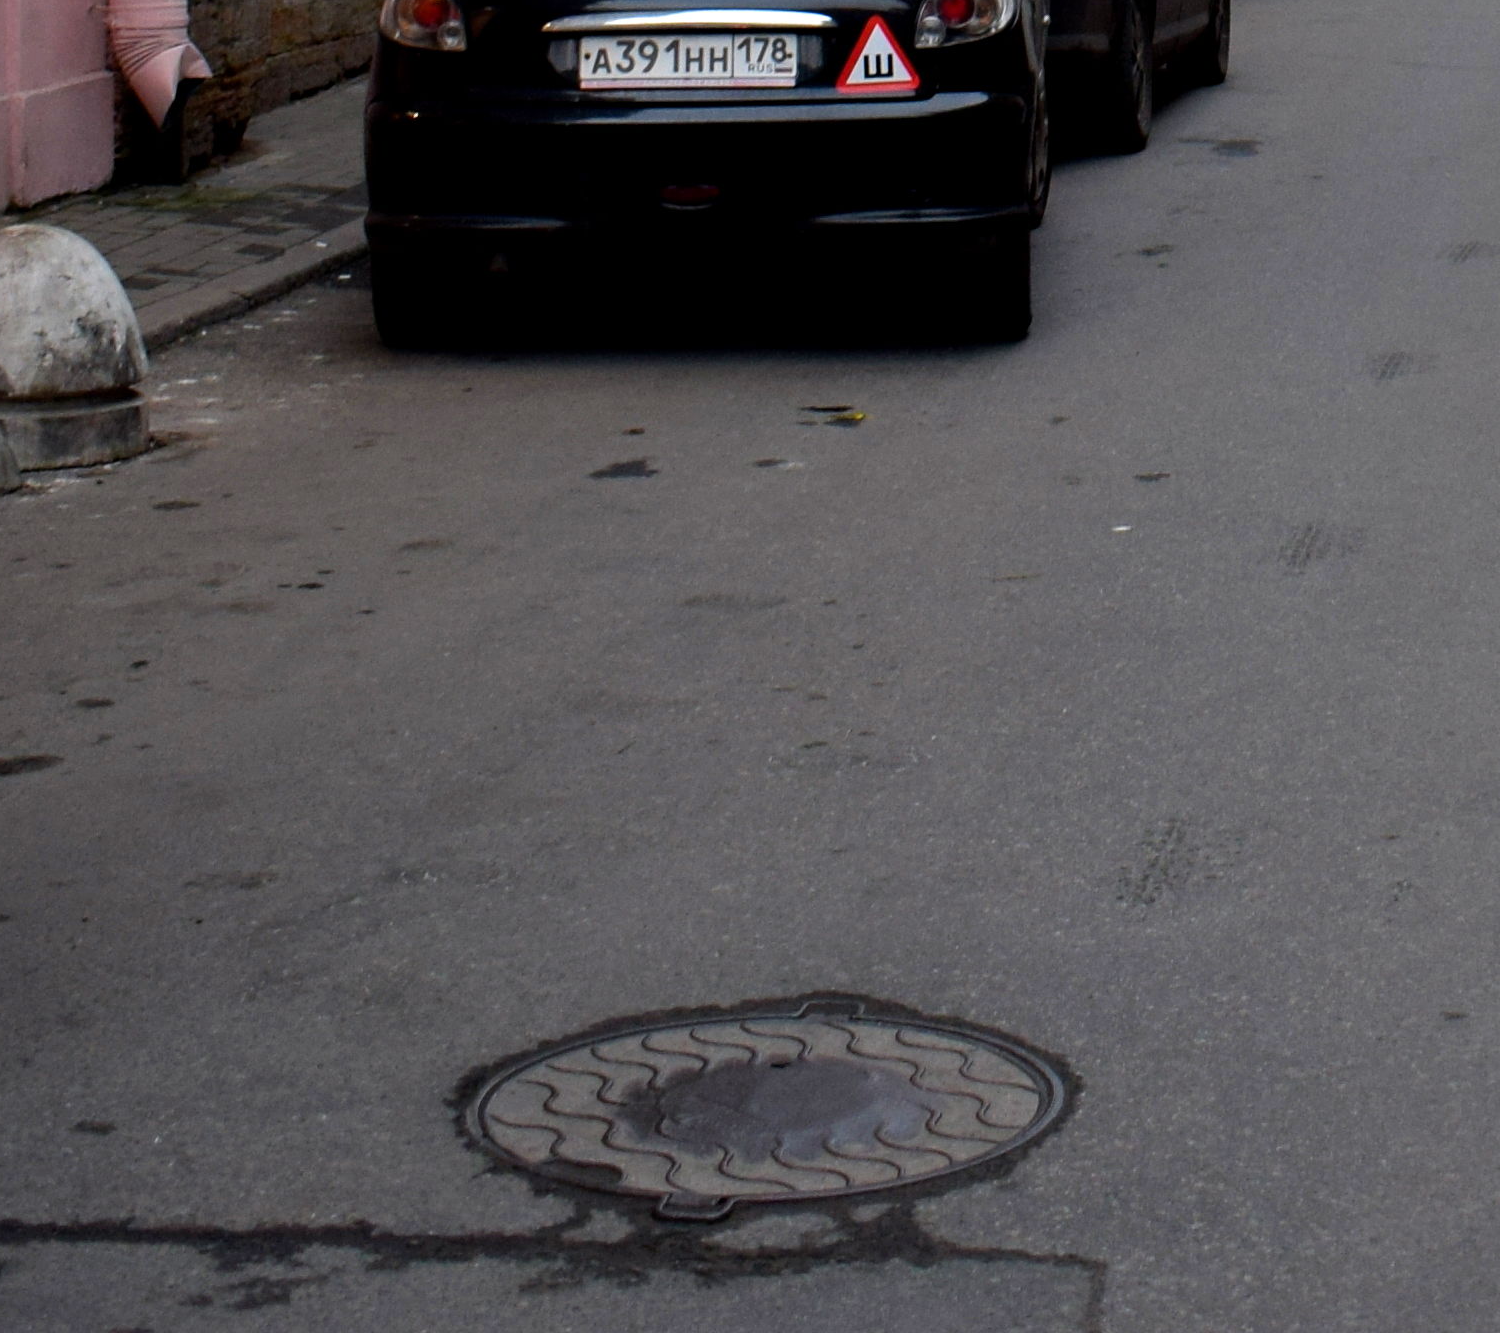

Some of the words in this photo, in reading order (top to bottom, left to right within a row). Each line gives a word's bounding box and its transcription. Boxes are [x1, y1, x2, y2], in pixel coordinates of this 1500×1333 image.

[592, 39, 729, 74] А391НН
[737, 37, 788, 63] 178
[864, 54, 894, 79] Ш
[748, 64, 774, 74] RUS
